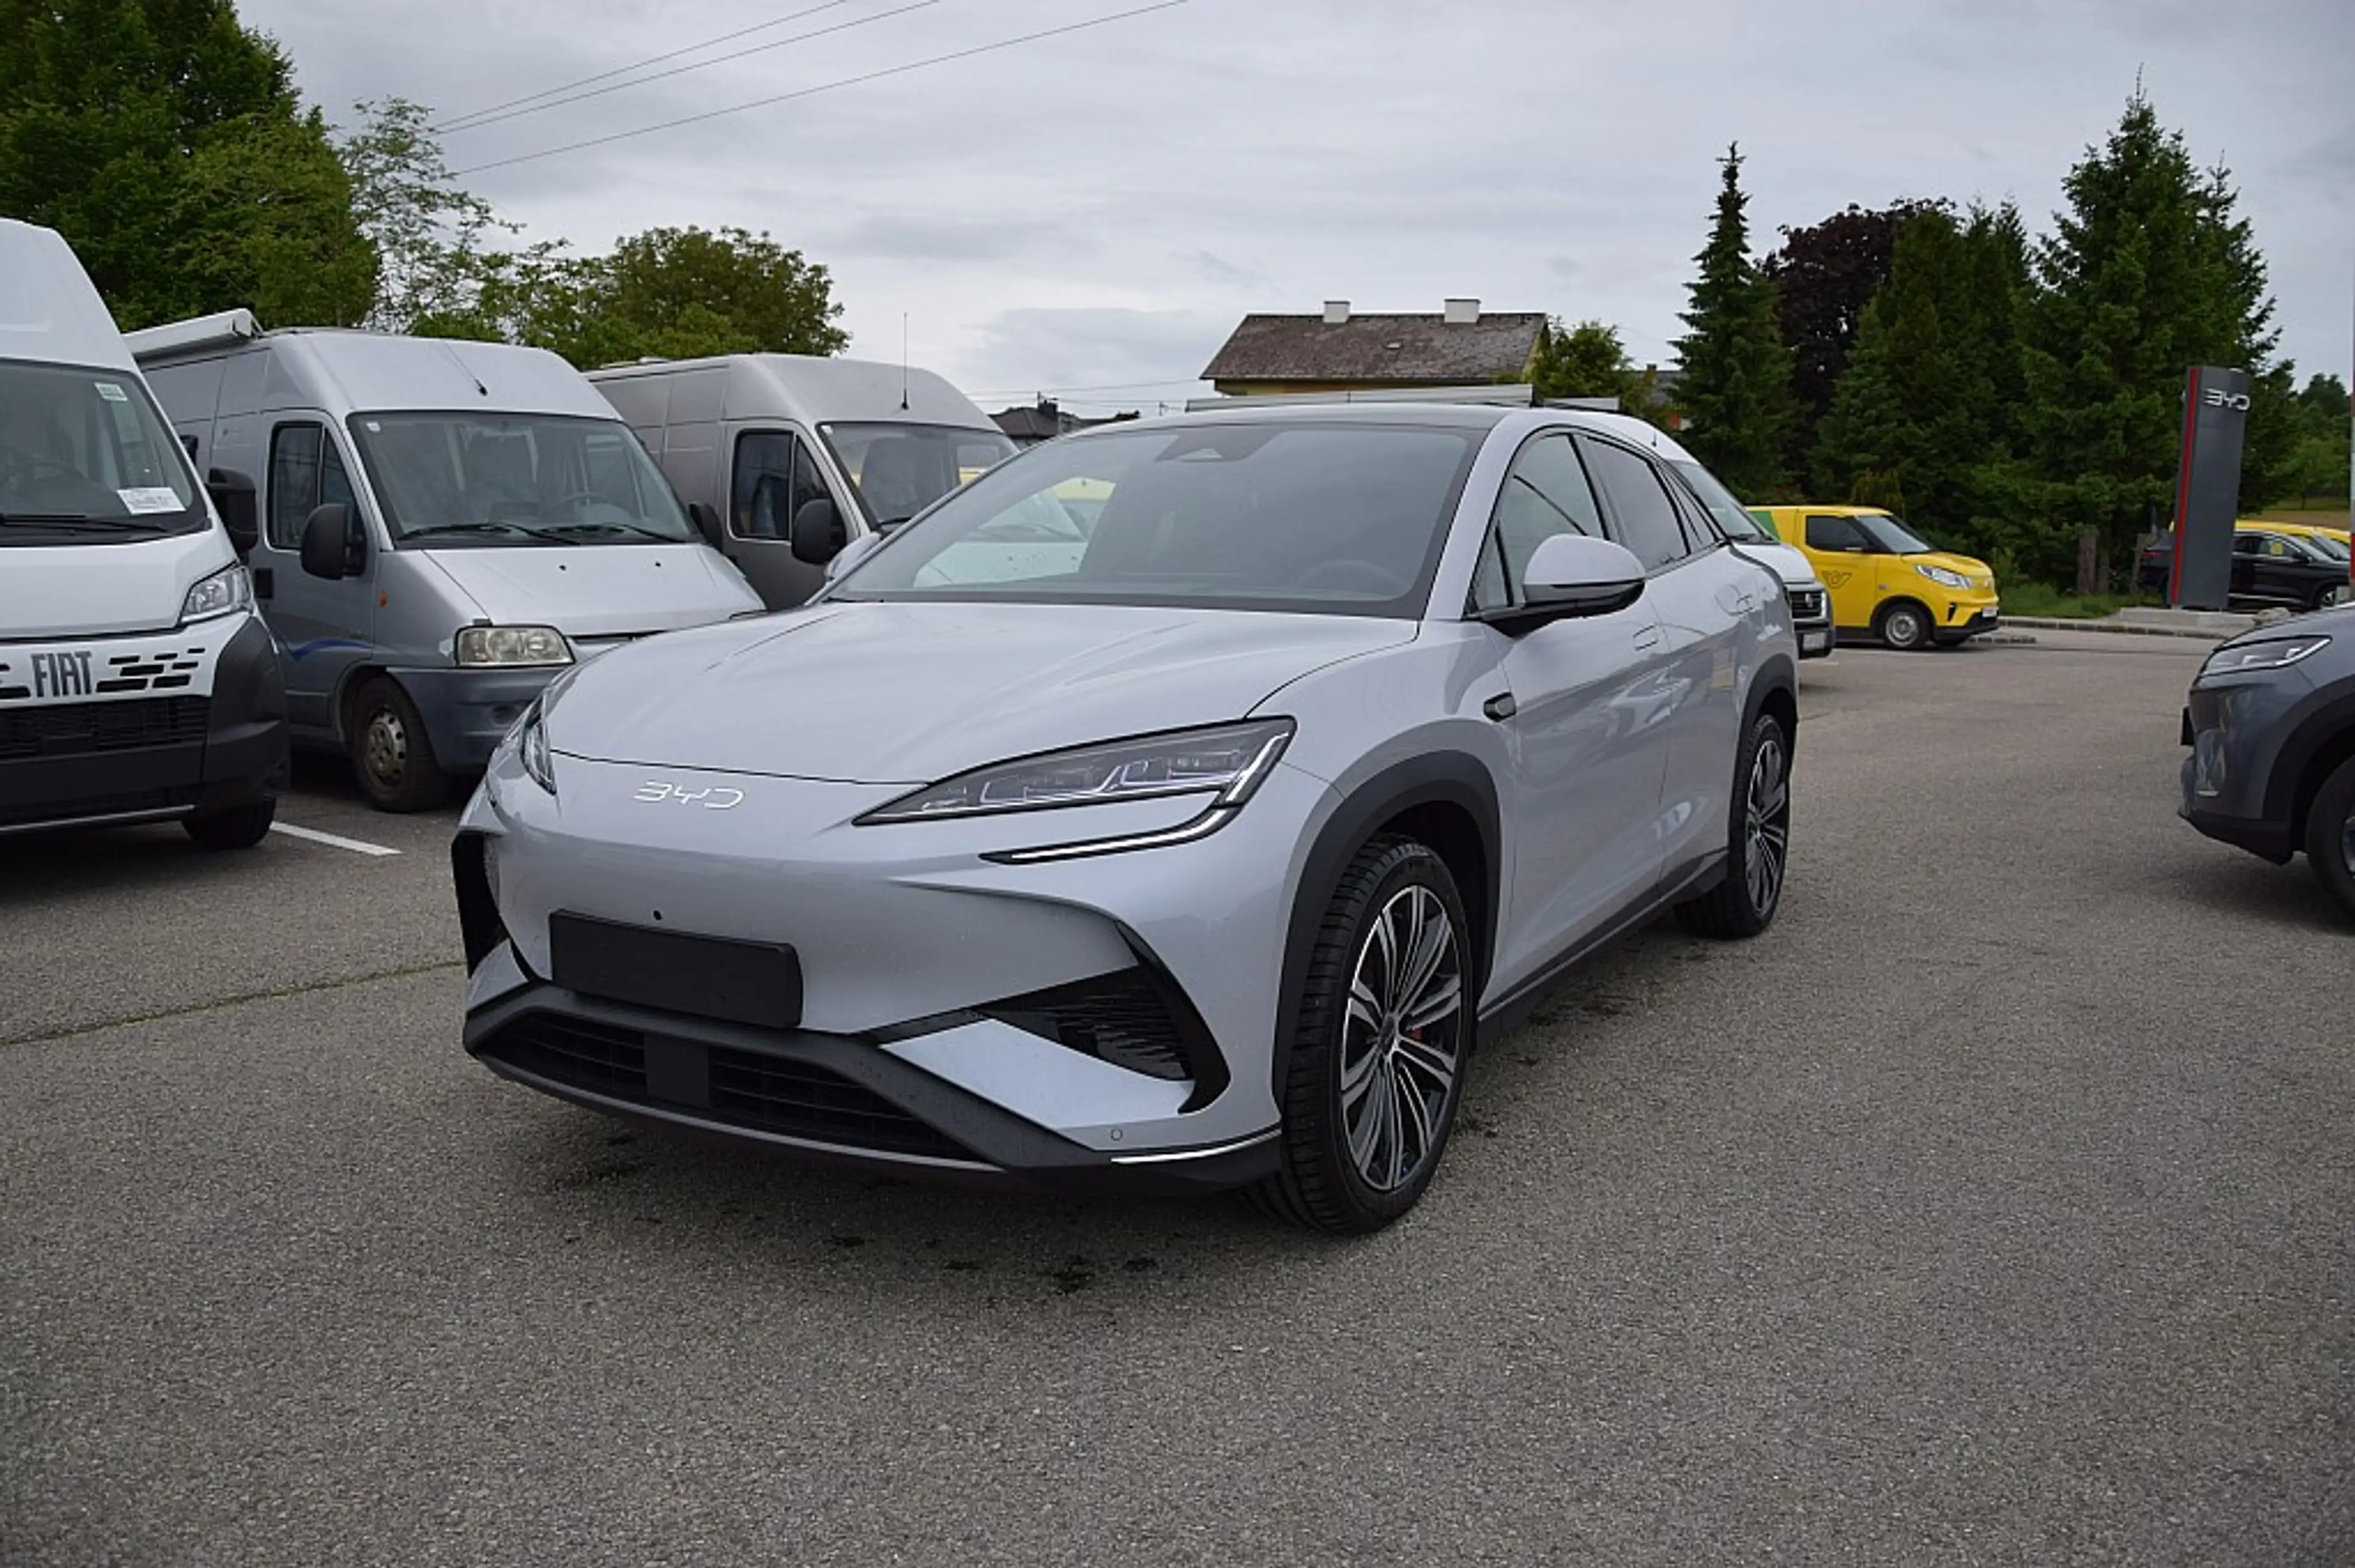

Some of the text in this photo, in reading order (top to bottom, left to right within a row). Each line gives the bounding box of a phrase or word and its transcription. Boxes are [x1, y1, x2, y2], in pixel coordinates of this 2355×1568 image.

[2204, 388, 2250, 410] BYD
[31, 651, 91, 697] FIAT
[634, 781, 744, 809] BYD
